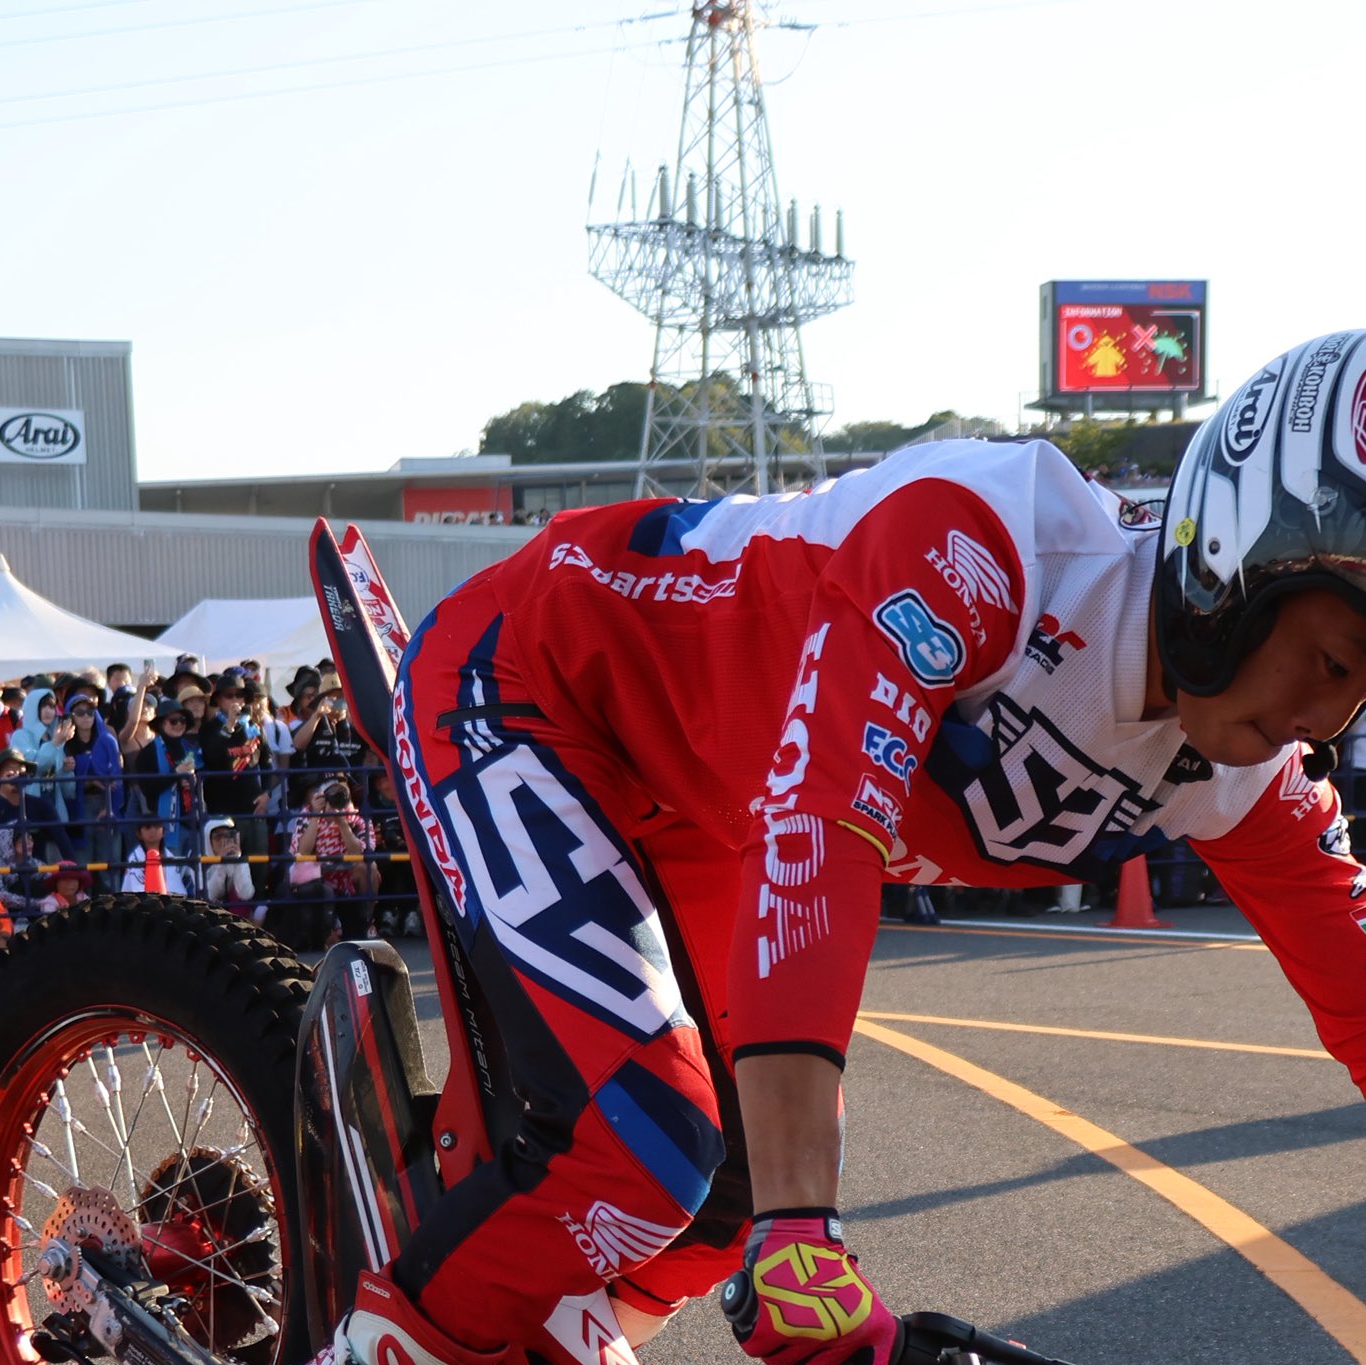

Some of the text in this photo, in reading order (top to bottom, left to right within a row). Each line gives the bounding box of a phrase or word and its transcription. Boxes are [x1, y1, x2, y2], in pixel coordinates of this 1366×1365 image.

[1063, 307, 1123, 318] INFORMATION
[1148, 284, 1192, 299] NSK
[6, 417, 70, 445] Arai
[1233, 369, 1278, 446] Arai
[924, 547, 987, 648] HONDA
[394, 680, 467, 917] HONDA
[853, 800, 888, 825] SPARK
[555, 1211, 619, 1283] HON
